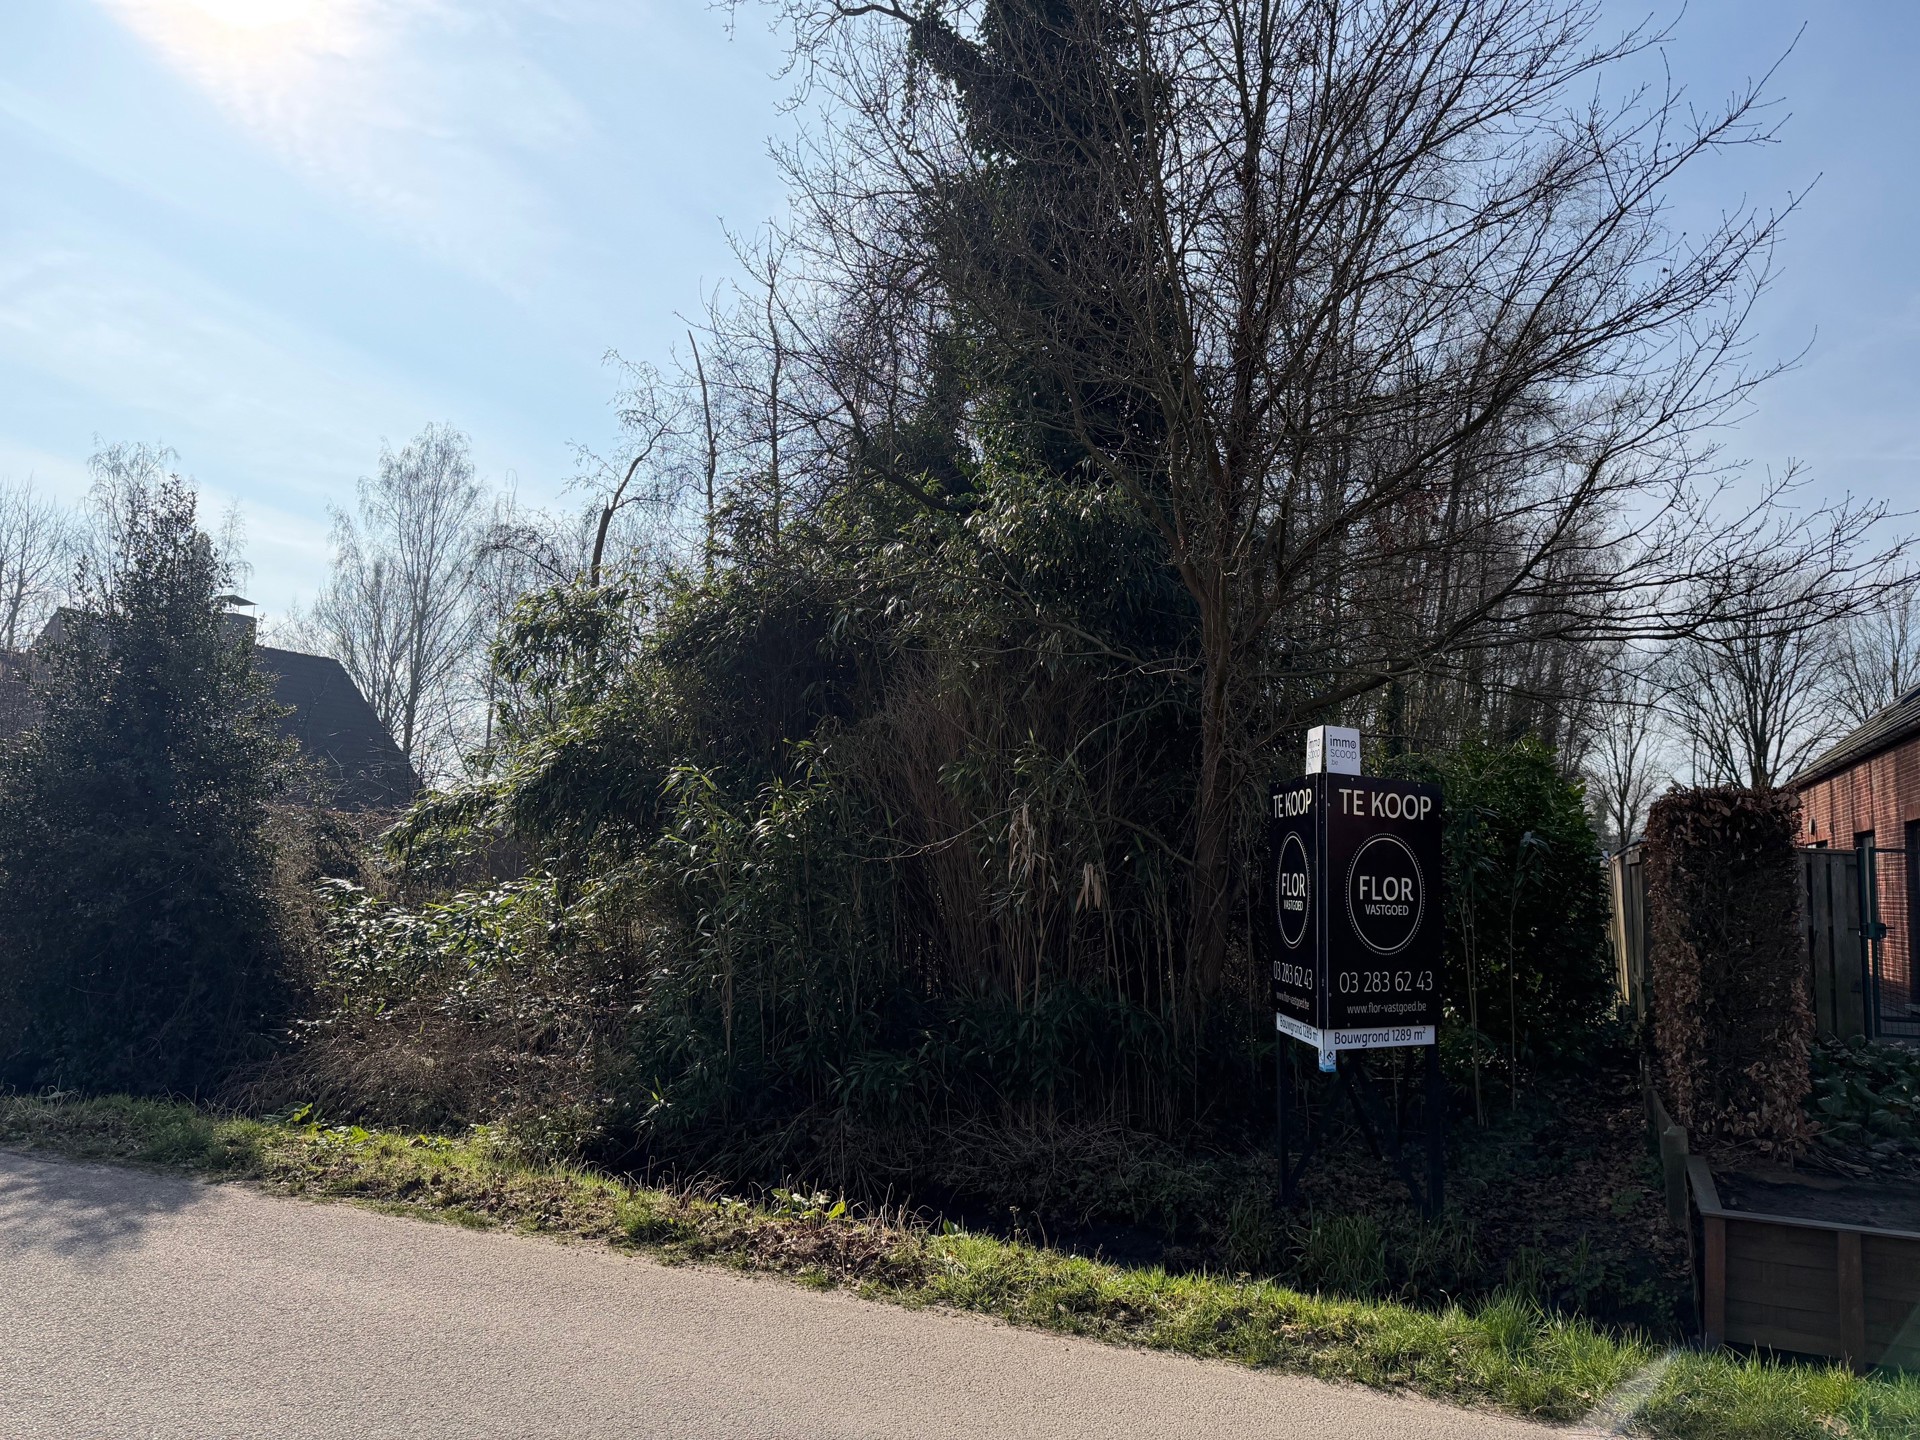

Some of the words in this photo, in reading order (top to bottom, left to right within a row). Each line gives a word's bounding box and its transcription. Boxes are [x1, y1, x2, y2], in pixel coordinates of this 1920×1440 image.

[1329, 734, 1357, 749] immo
[1330, 749, 1357, 761] scoop
[1272, 794, 1284, 818] TE
[1285, 788, 1312, 816] KOOP
[1339, 788, 1365, 816] TE
[1371, 791, 1432, 821] KOOP
[1281, 872, 1306, 897] FLOR
[1359, 875, 1414, 902] FLOR
[1365, 904, 1409, 916] VASTGOED
[1273, 960, 1281, 981] 03
[1282, 962, 1294, 985] 283
[1294, 966, 1303, 988] 62
[1304, 968, 1313, 990] 43
[1339, 971, 1359, 994] 03
[1363, 971, 1391, 993] 283
[1394, 971, 1412, 992] 62
[1416, 970, 1433, 991] 43
[1347, 1001, 1427, 1016] www.flor-vastgoed.be
[1334, 1030, 1390, 1047] Bouwgrond
[1392, 1029, 1412, 1042] 1289
